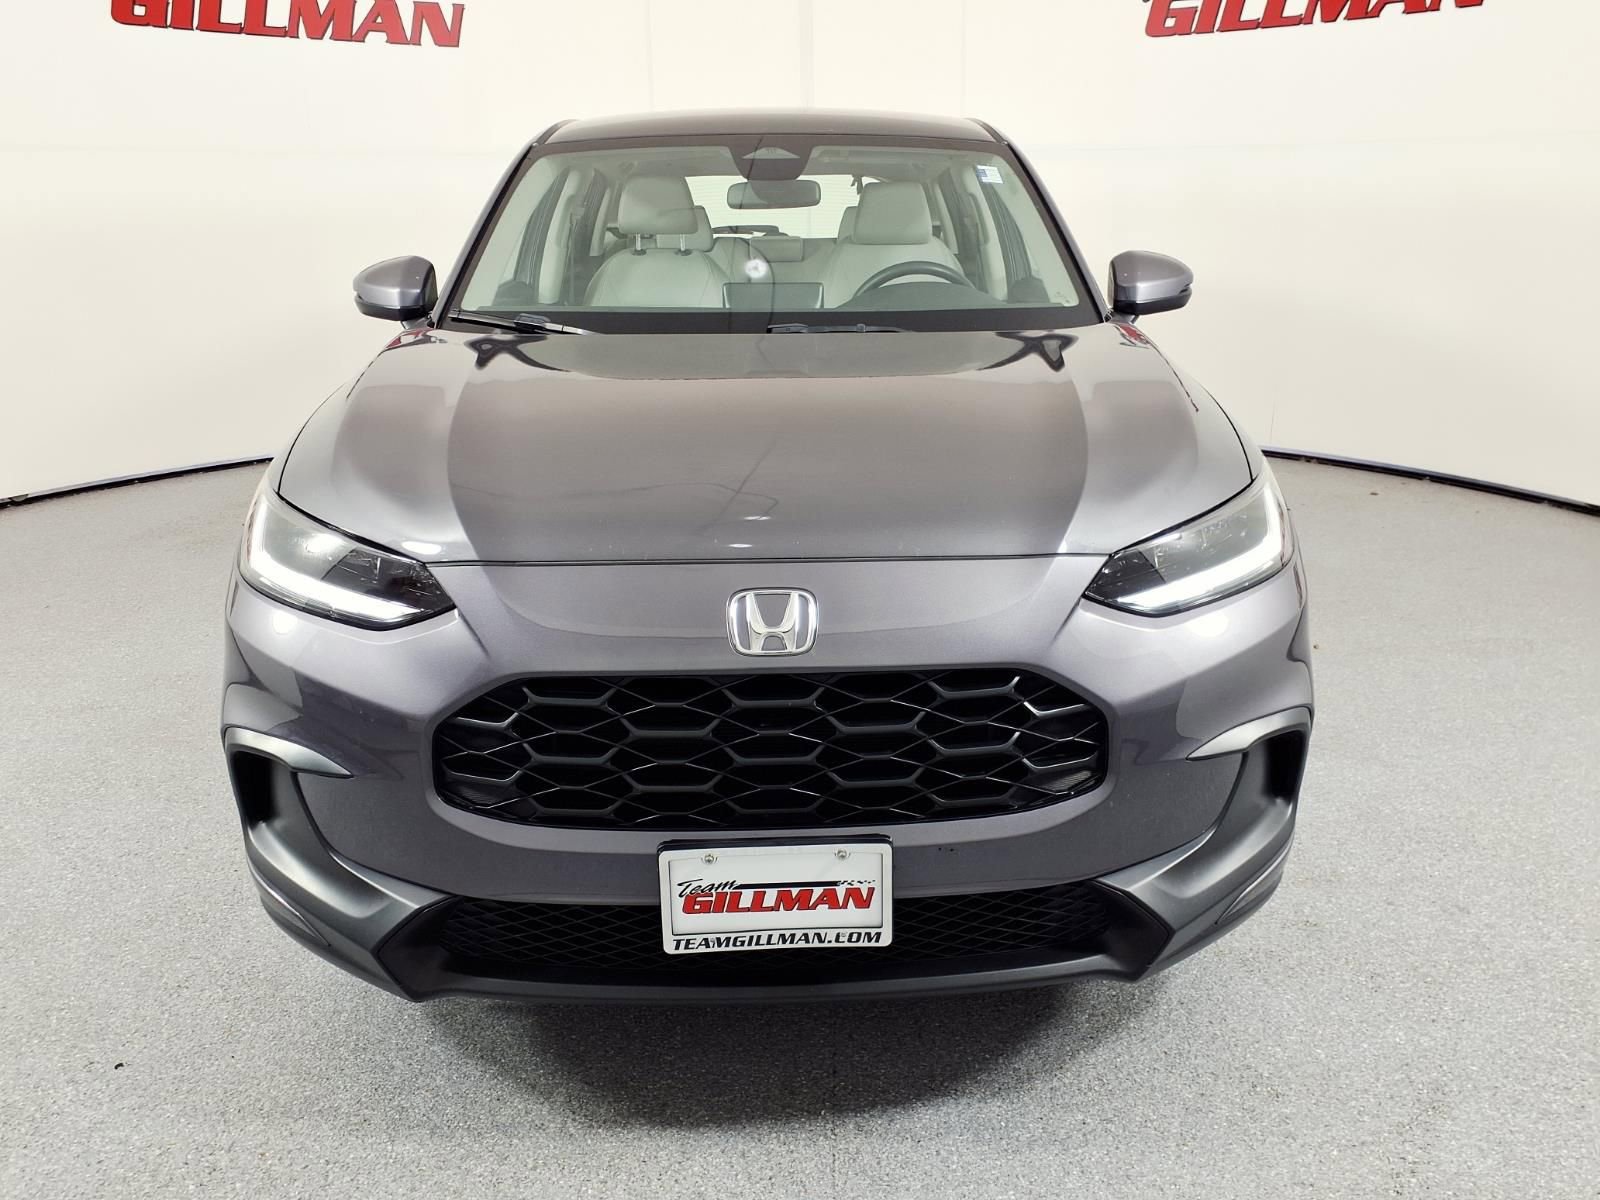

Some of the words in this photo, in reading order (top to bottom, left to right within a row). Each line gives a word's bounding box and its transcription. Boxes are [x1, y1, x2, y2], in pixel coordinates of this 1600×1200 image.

[677, 878, 739, 898] Team
[682, 887, 875, 914] GILLMAN
[673, 931, 882, 951] TEAMGILLMAN.COM
